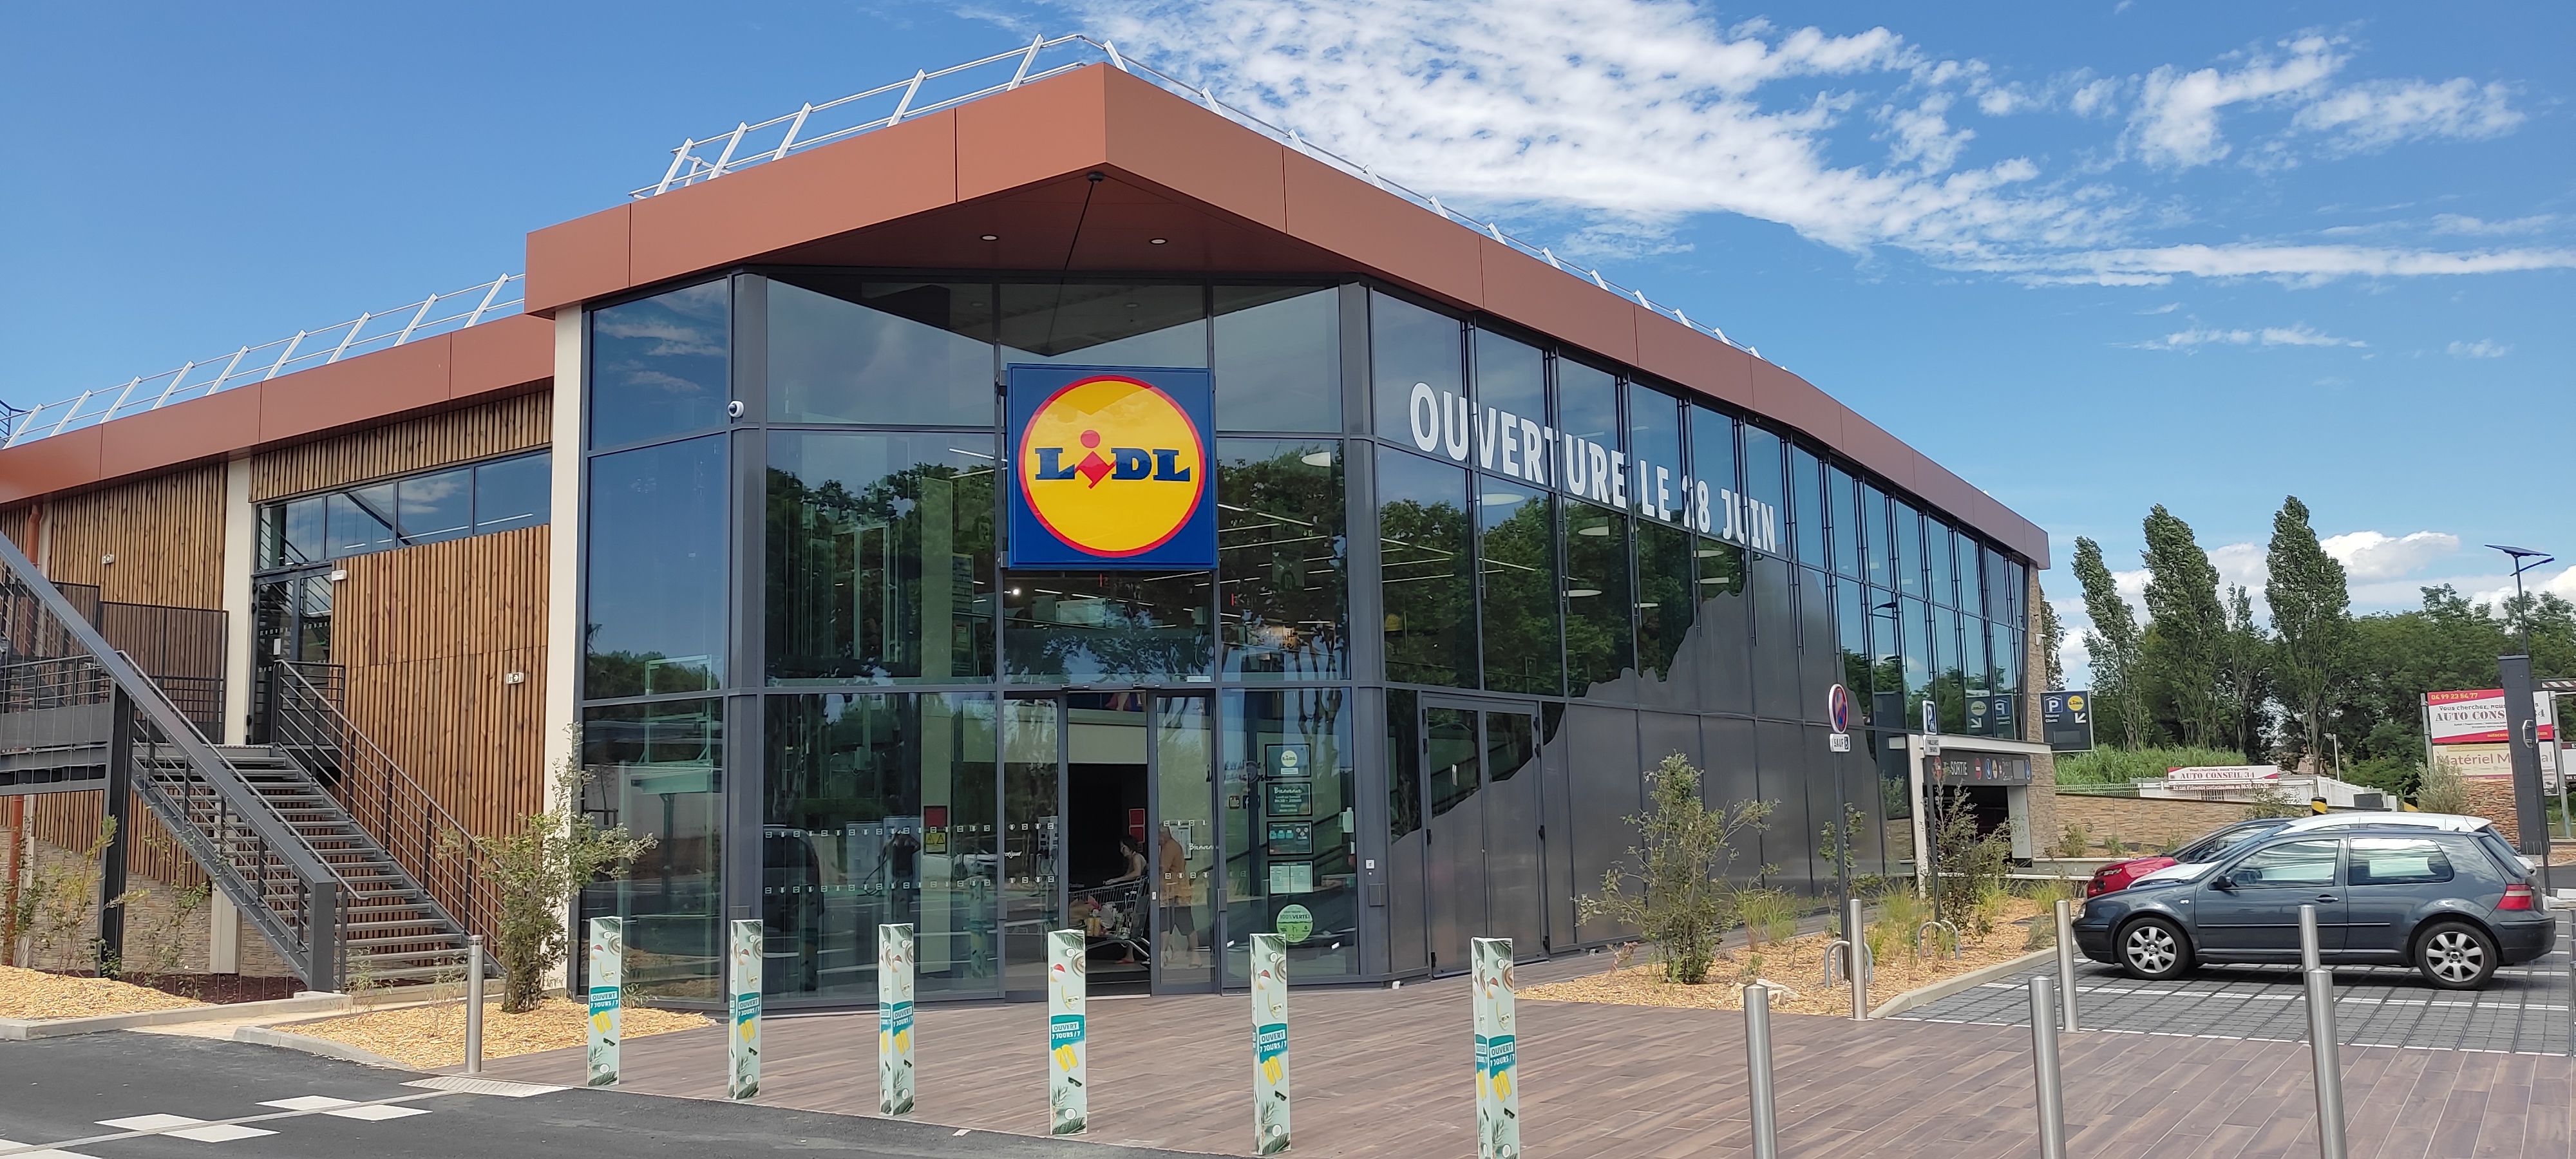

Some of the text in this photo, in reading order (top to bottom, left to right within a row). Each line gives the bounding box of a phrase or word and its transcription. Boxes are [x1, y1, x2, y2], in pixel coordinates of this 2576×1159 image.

[1410, 382, 1627, 510] OUVERTURE
[1639, 459, 1671, 522] LE
[1721, 487, 1776, 553] JUIN
[2436, 711, 2468, 721] AUTO
[2472, 710, 2505, 720] CONS
[1950, 761, 1968, 776] SORTIE
[895, 1008, 911, 1018] OUVERT
[1262, 1032, 1283, 1042] OUVERT
[1492, 1044, 1511, 1055] OUVERT
